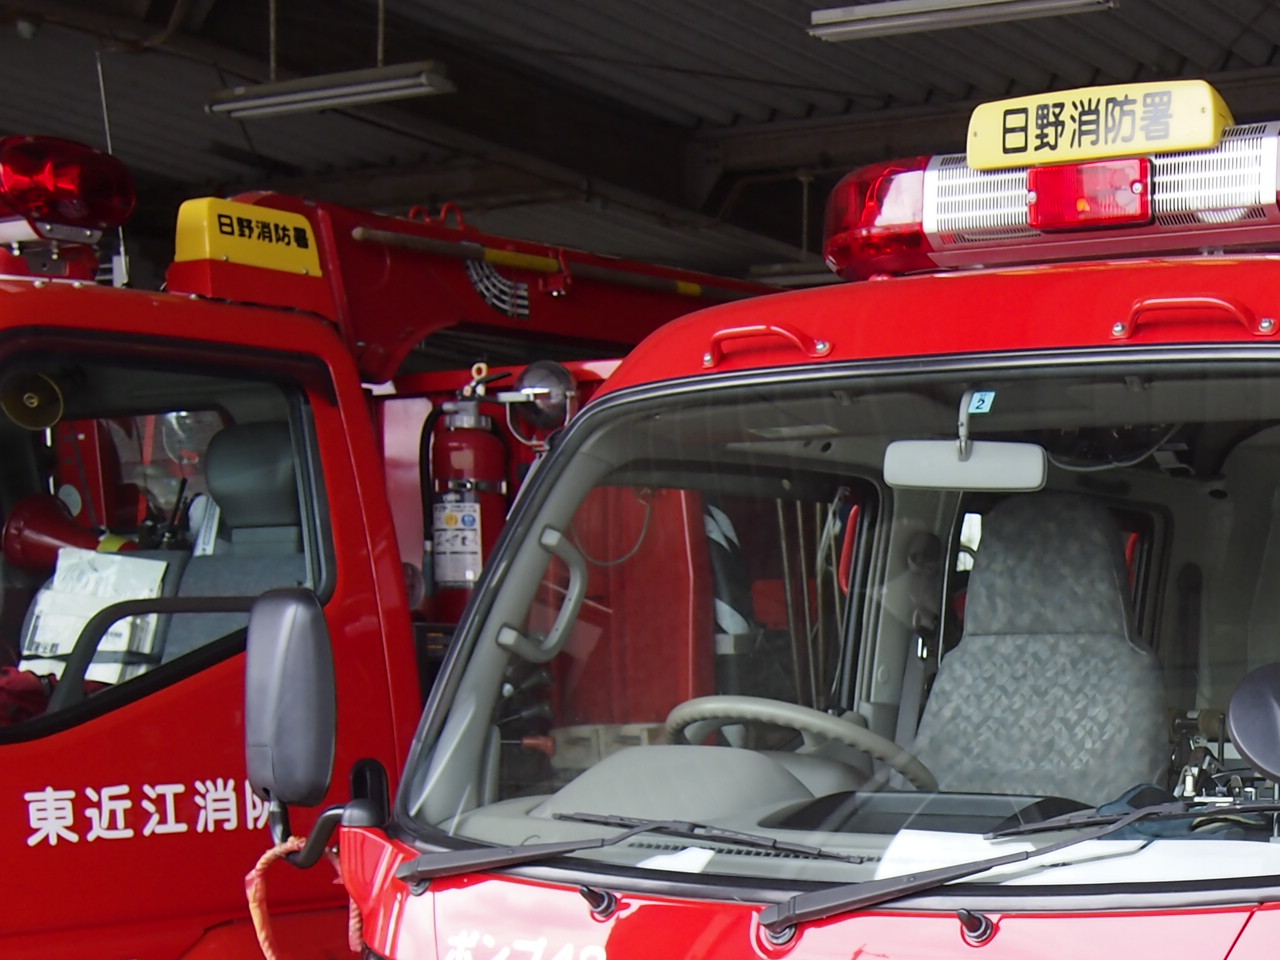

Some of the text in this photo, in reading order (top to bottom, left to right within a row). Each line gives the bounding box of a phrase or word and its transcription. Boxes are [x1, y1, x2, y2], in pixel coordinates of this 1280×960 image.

[1002, 90, 1173, 154] 日野消防署
[217, 213, 309, 249] 日野消防署
